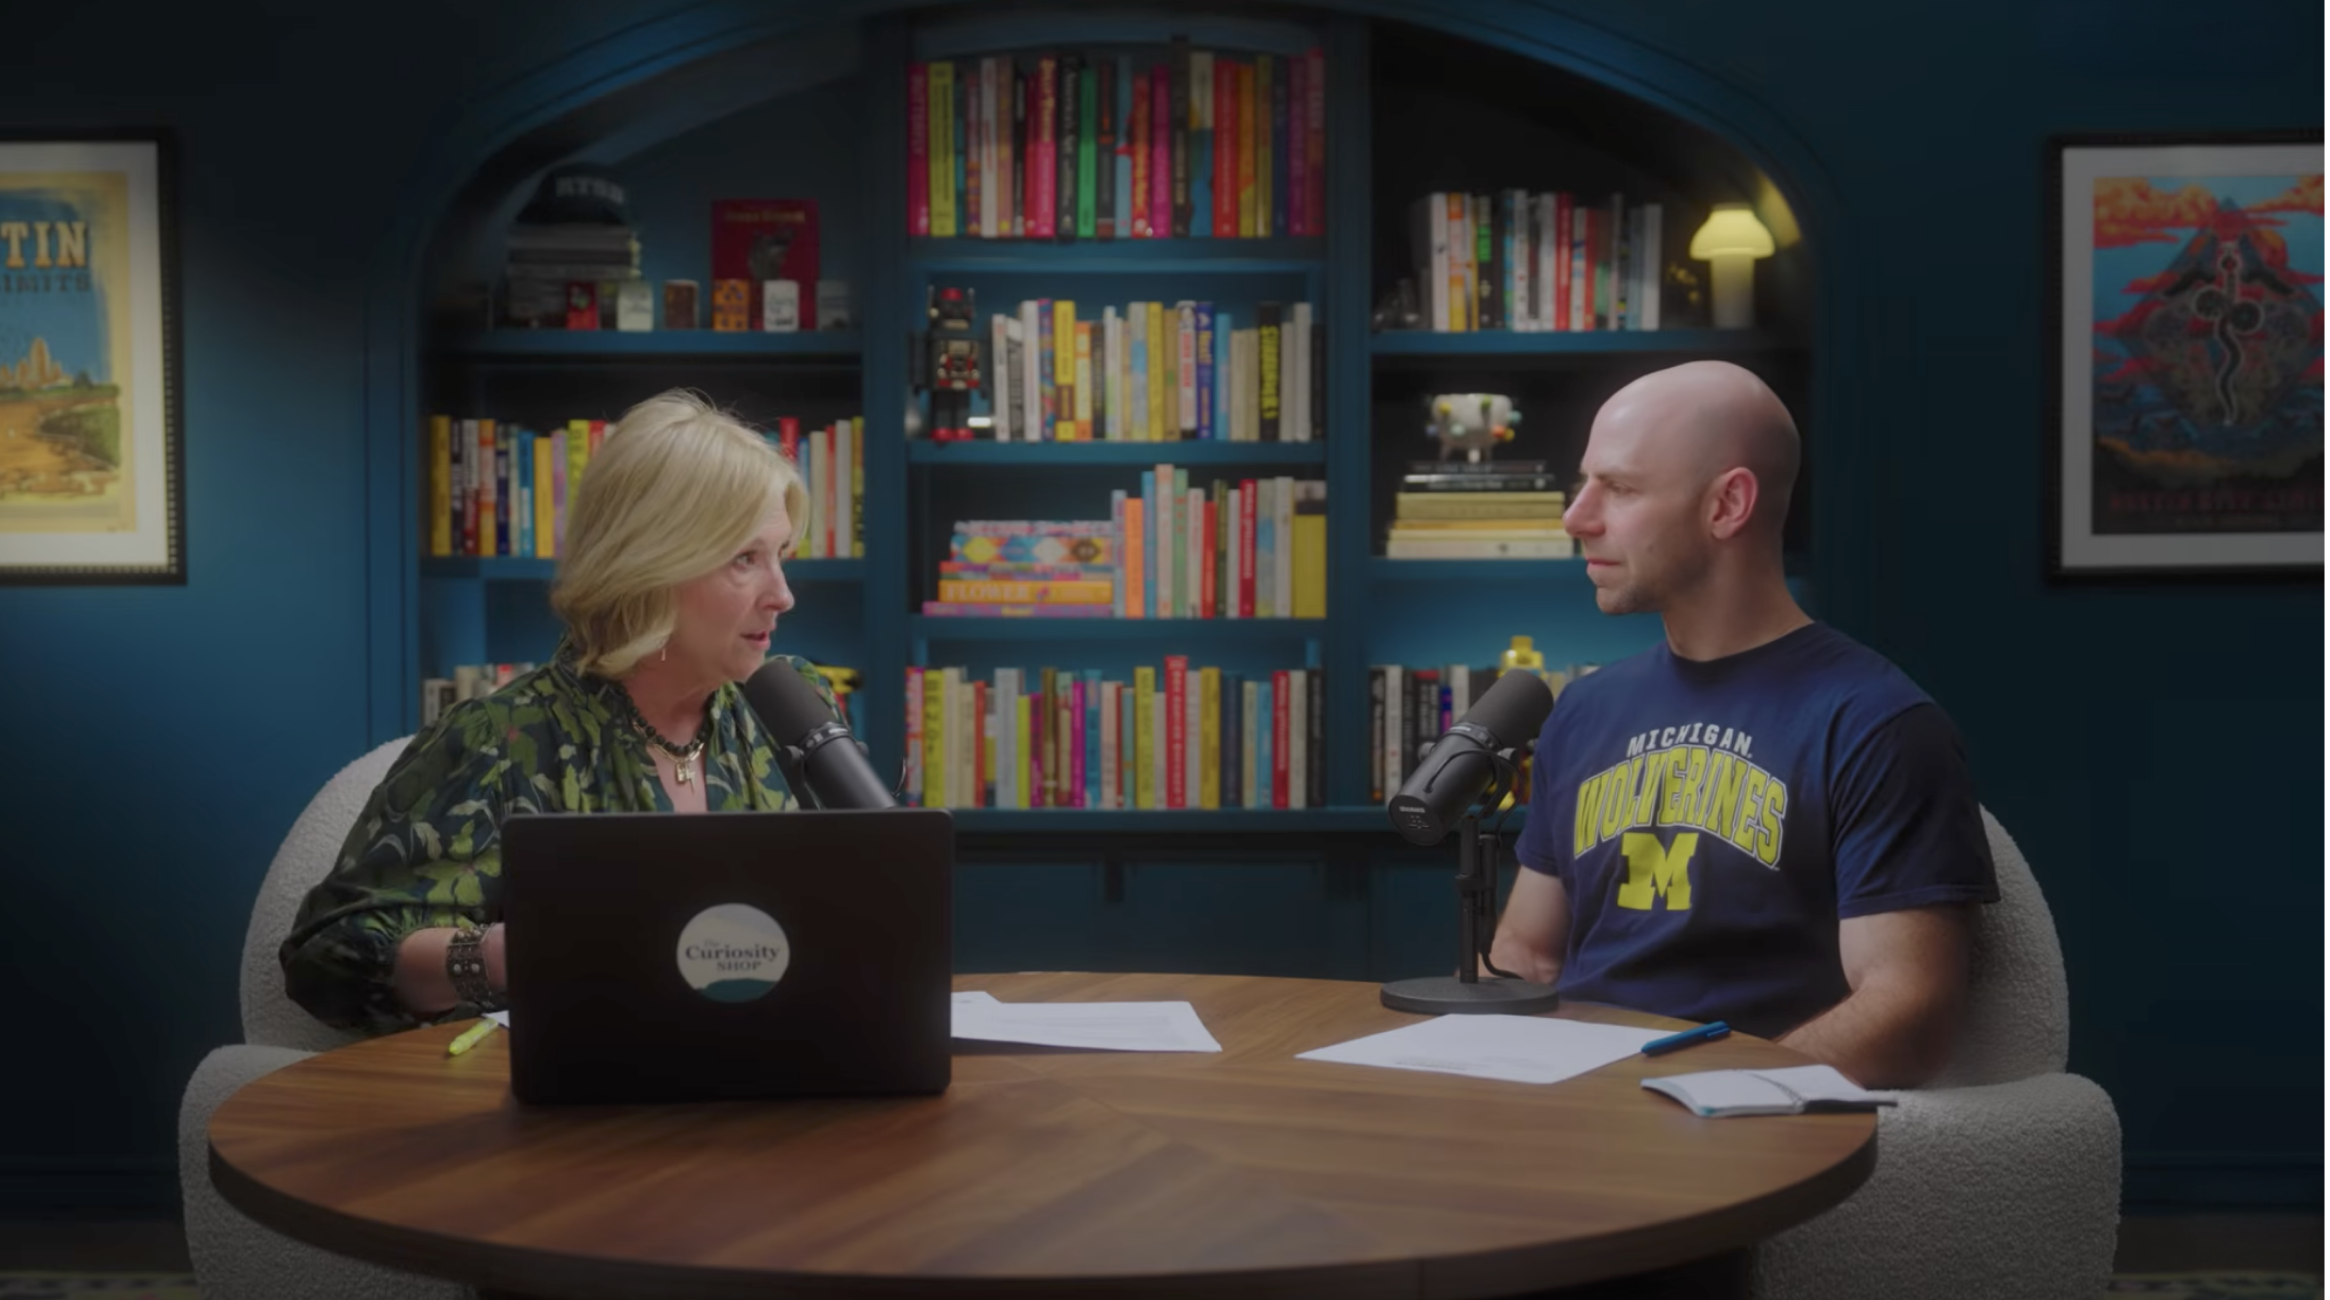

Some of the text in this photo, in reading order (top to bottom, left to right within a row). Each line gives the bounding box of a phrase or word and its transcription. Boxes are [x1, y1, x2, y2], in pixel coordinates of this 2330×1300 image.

[0, 220, 88, 268] TIN
[946, 584, 1030, 601] FLOWER
[1574, 744, 1788, 869] WOLVERINES
[1617, 832, 1699, 911] M
[685, 944, 780, 962] Curiosity
[717, 961, 761, 972] SHOP
